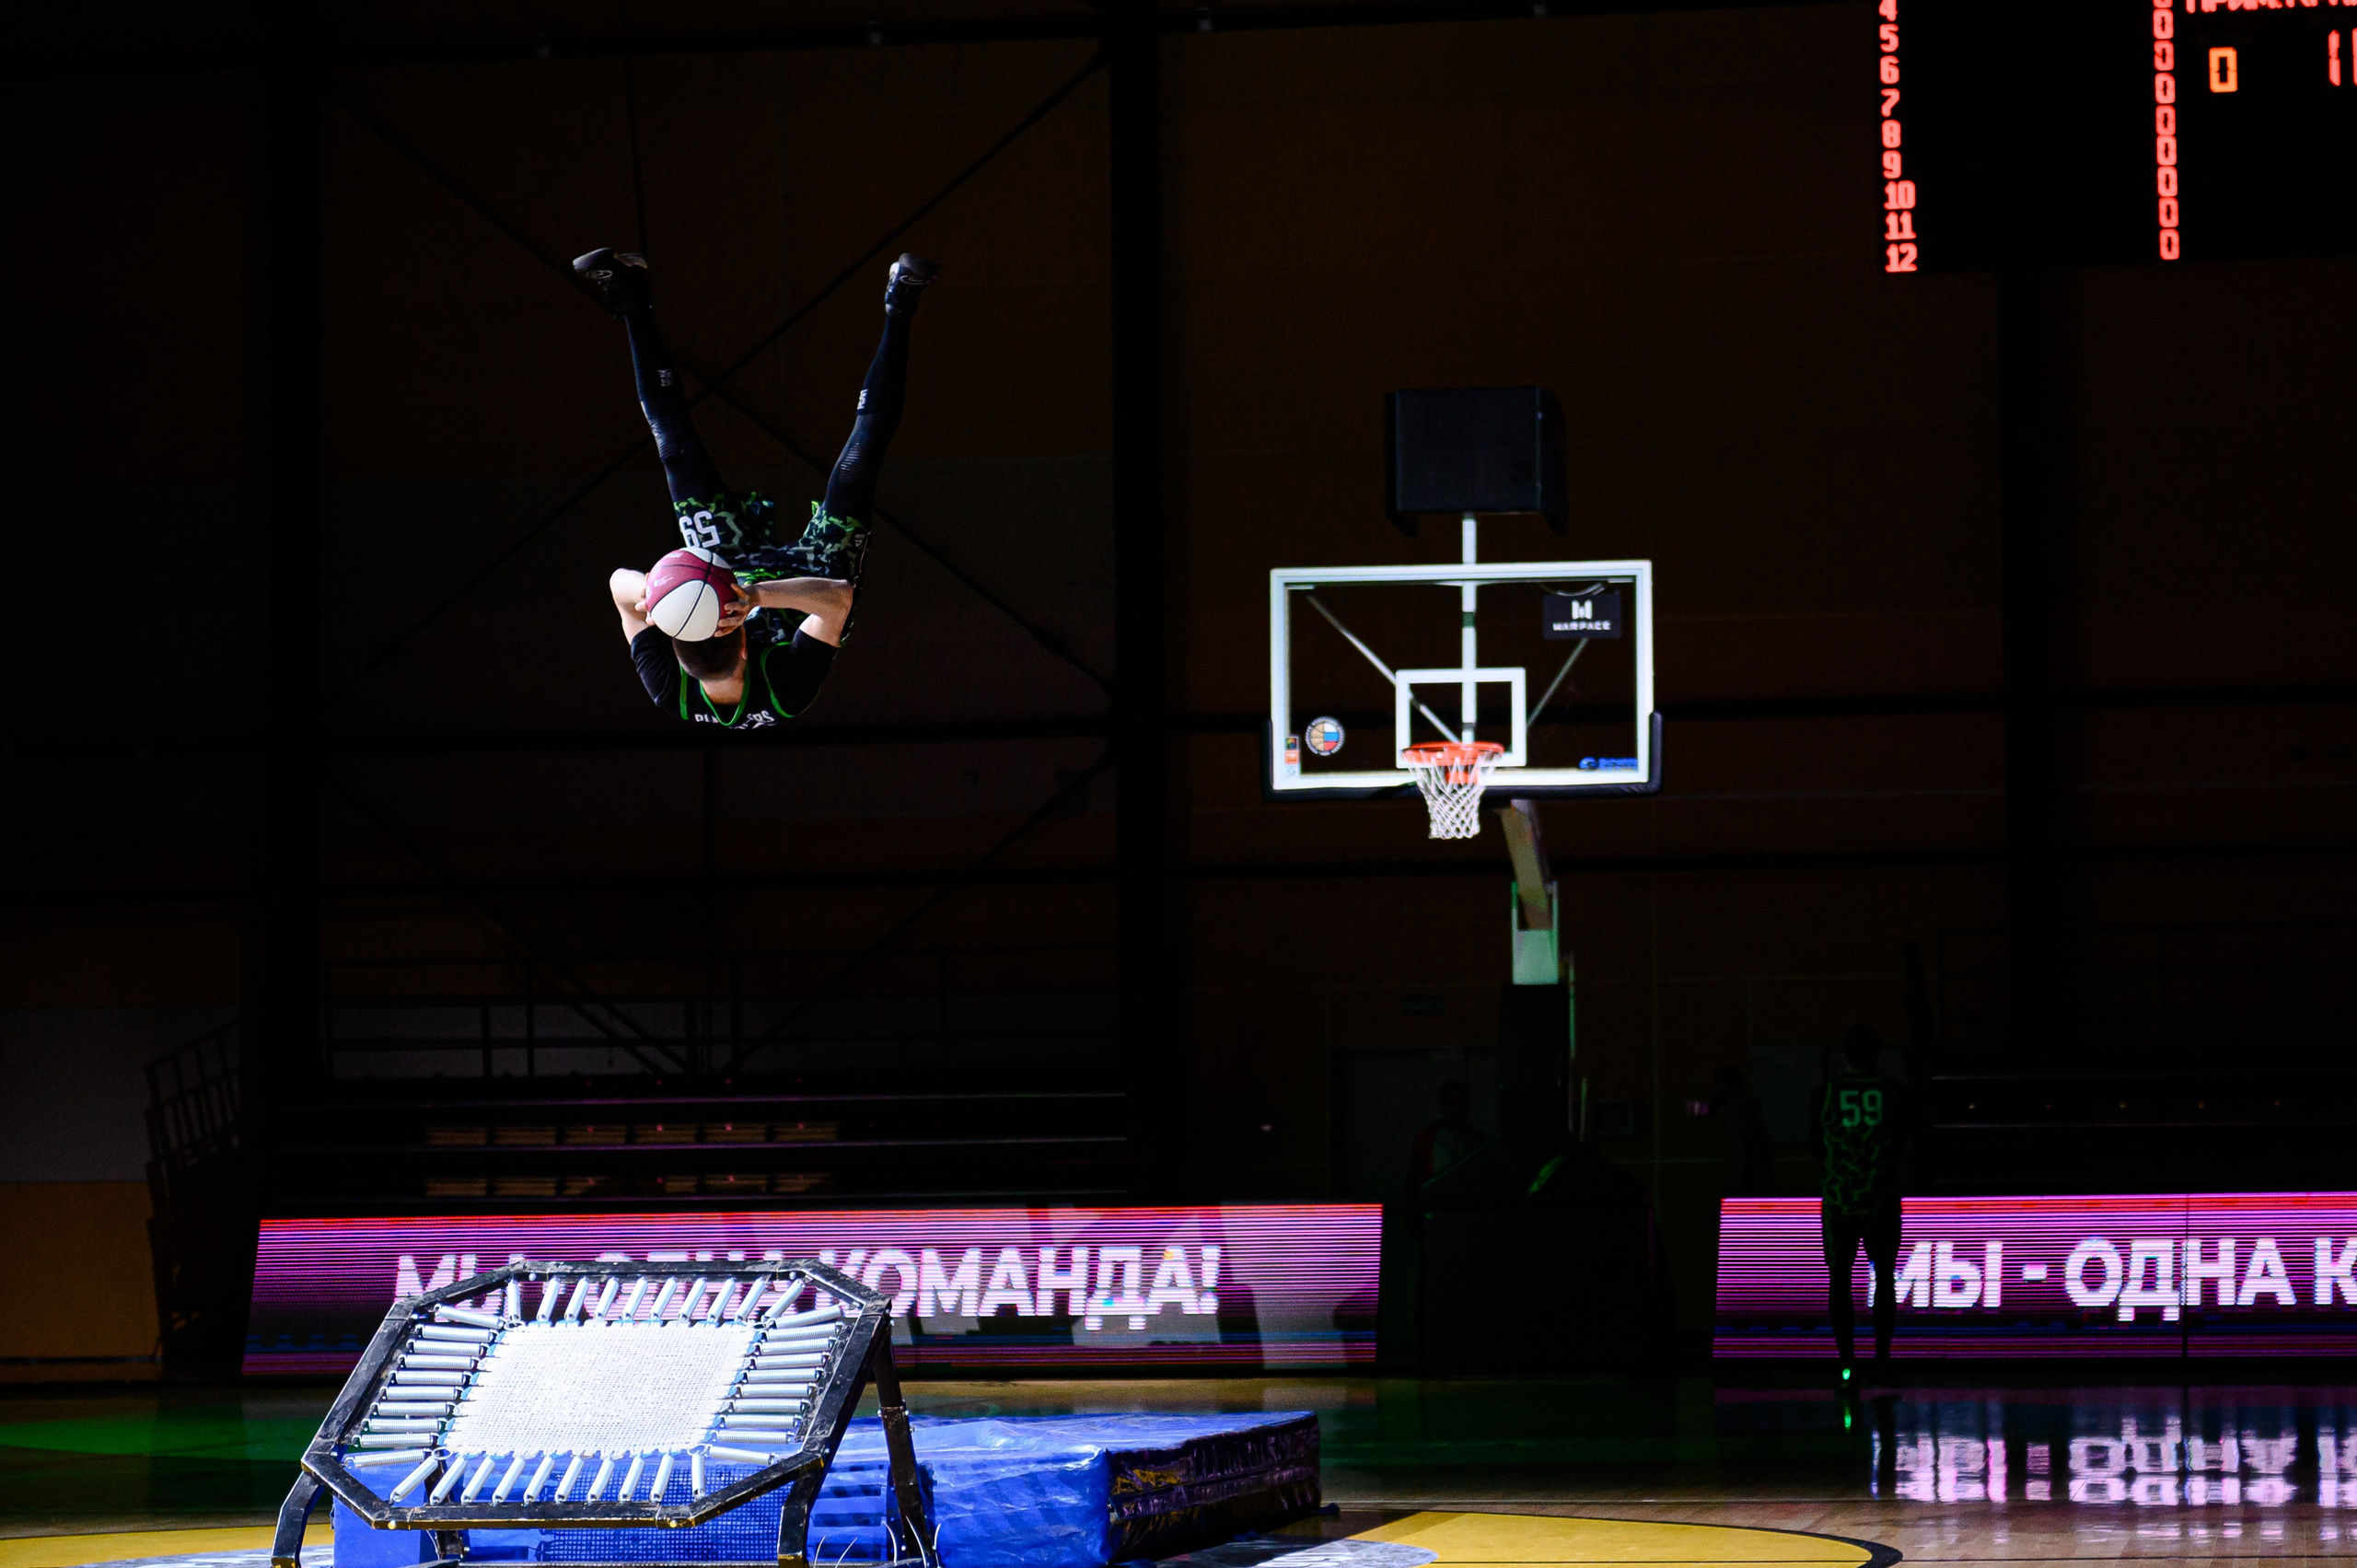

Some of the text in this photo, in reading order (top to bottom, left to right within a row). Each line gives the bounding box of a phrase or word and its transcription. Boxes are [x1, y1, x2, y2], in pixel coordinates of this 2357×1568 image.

[1879, 23, 1899, 52] 5
[2153, 8, 2174, 40] 0
[1879, 40, 2175, 84] 6 0
[2208, 46, 2239, 93] 0
[1880, 72, 2176, 118] 7 0
[1881, 104, 2177, 148] 8 0
[1883, 135, 2177, 179] 9 0
[1884, 166, 2178, 210] 10 0
[1885, 196, 2179, 240] 11 0
[1886, 227, 2180, 273] 12 0
[1839, 1088, 1884, 1128] 59
[2064, 1236, 2298, 1321] ОДНА
